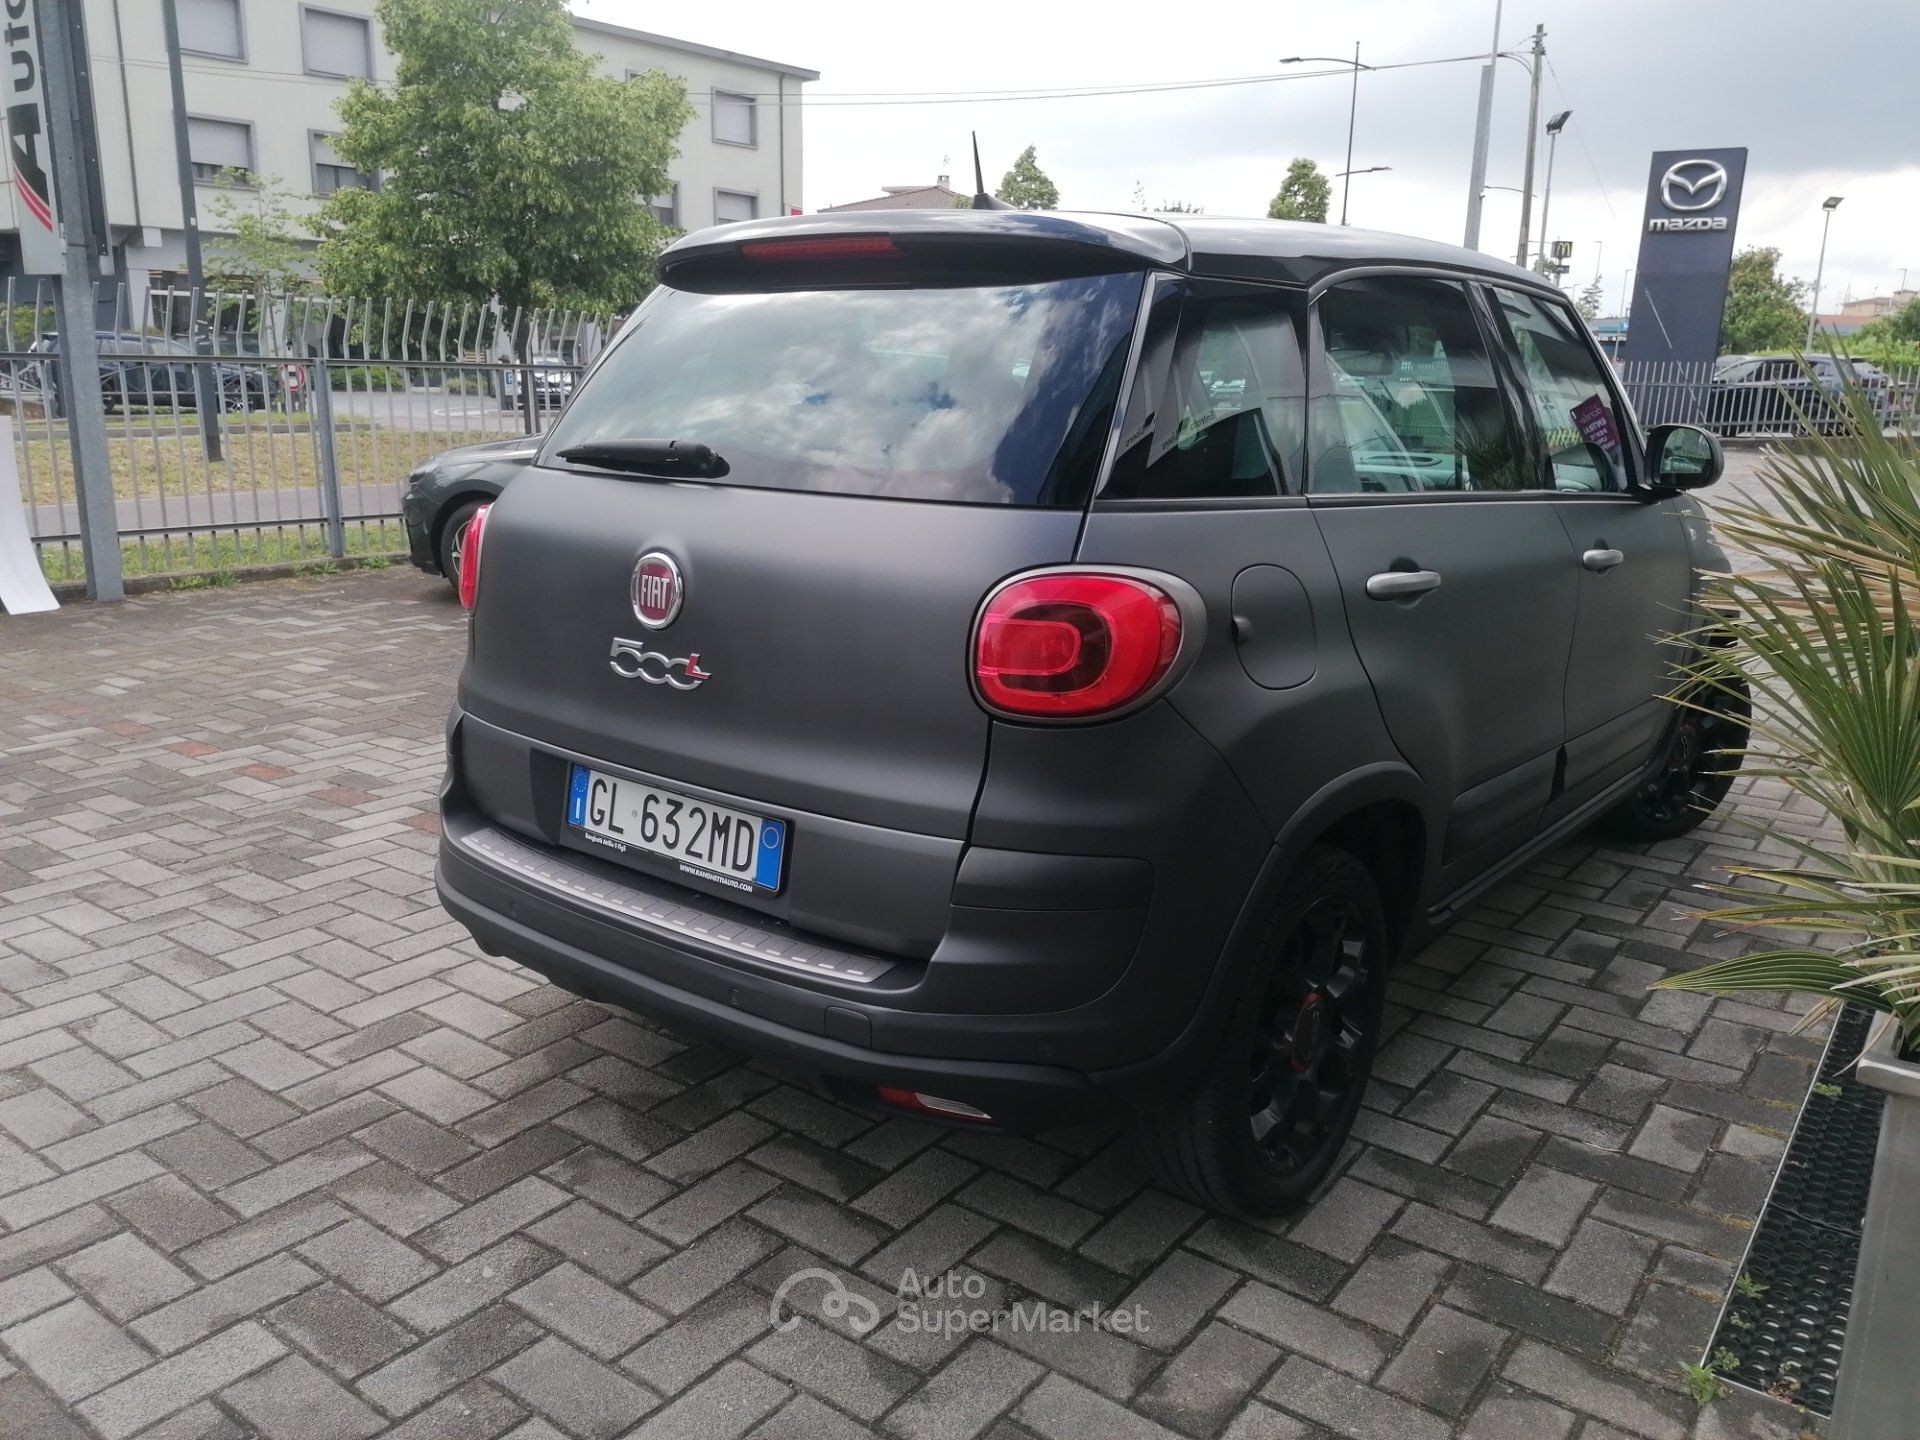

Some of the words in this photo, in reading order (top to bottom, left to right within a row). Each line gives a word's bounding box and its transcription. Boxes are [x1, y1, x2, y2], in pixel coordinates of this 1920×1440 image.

[1648, 216, 1728, 232] mazda
[640, 574, 671, 610] FIAT
[609, 636, 713, 692] 500L
[589, 778, 624, 835] GL
[640, 793, 755, 873] 632MD
